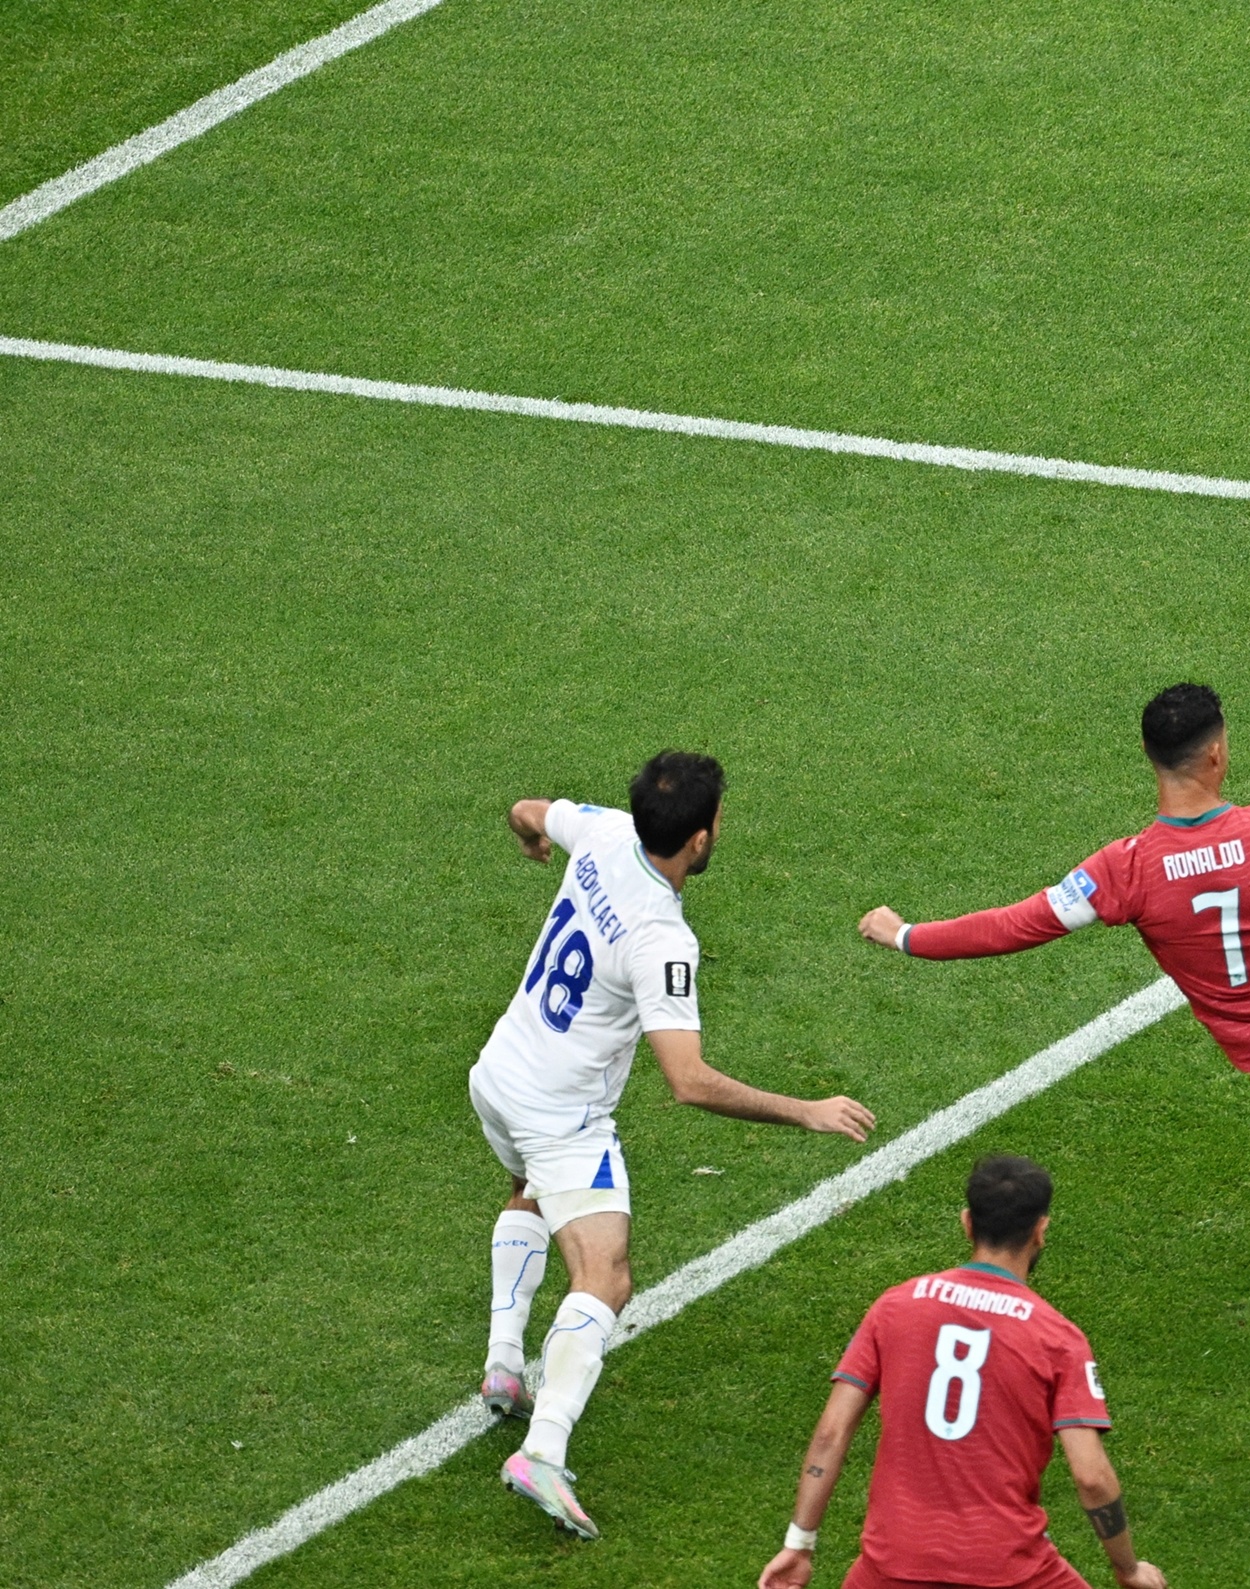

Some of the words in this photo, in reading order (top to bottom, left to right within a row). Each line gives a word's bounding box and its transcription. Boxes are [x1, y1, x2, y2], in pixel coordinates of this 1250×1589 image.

[1162, 839, 1246, 881] RONALDO
[525, 898, 594, 1033] 18
[1191, 887, 1248, 987] 7
[912, 1278, 1034, 1321] B.FERNANDES
[924, 1323, 992, 1441] 8
